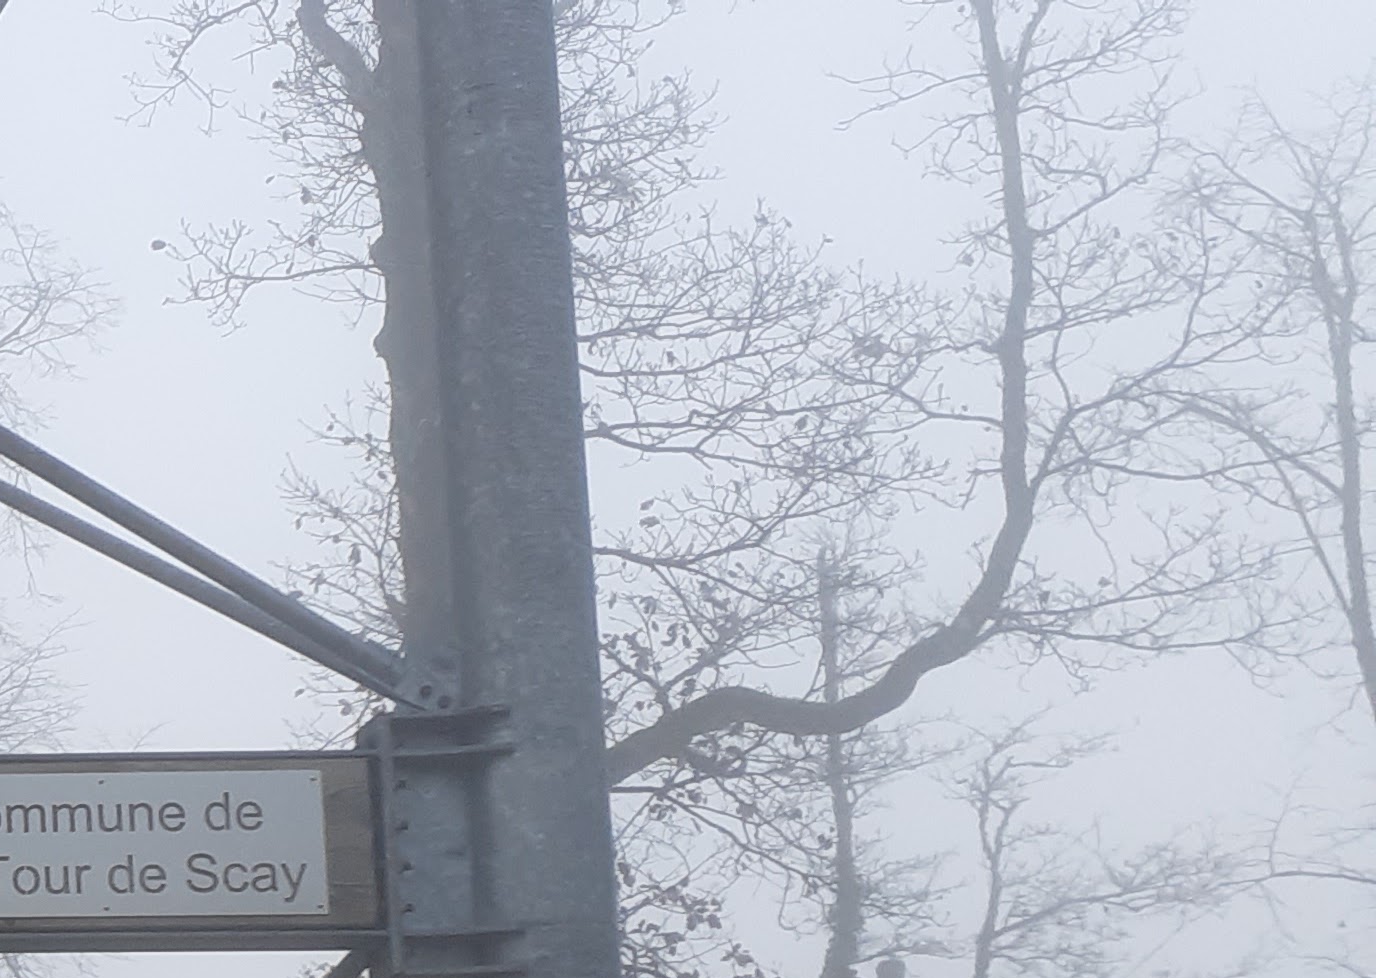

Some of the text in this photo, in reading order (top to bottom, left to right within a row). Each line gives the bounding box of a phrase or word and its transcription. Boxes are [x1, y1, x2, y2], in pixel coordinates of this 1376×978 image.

[204, 791, 264, 832] de
[107, 854, 167, 894] de
[186, 852, 308, 904] Scay
